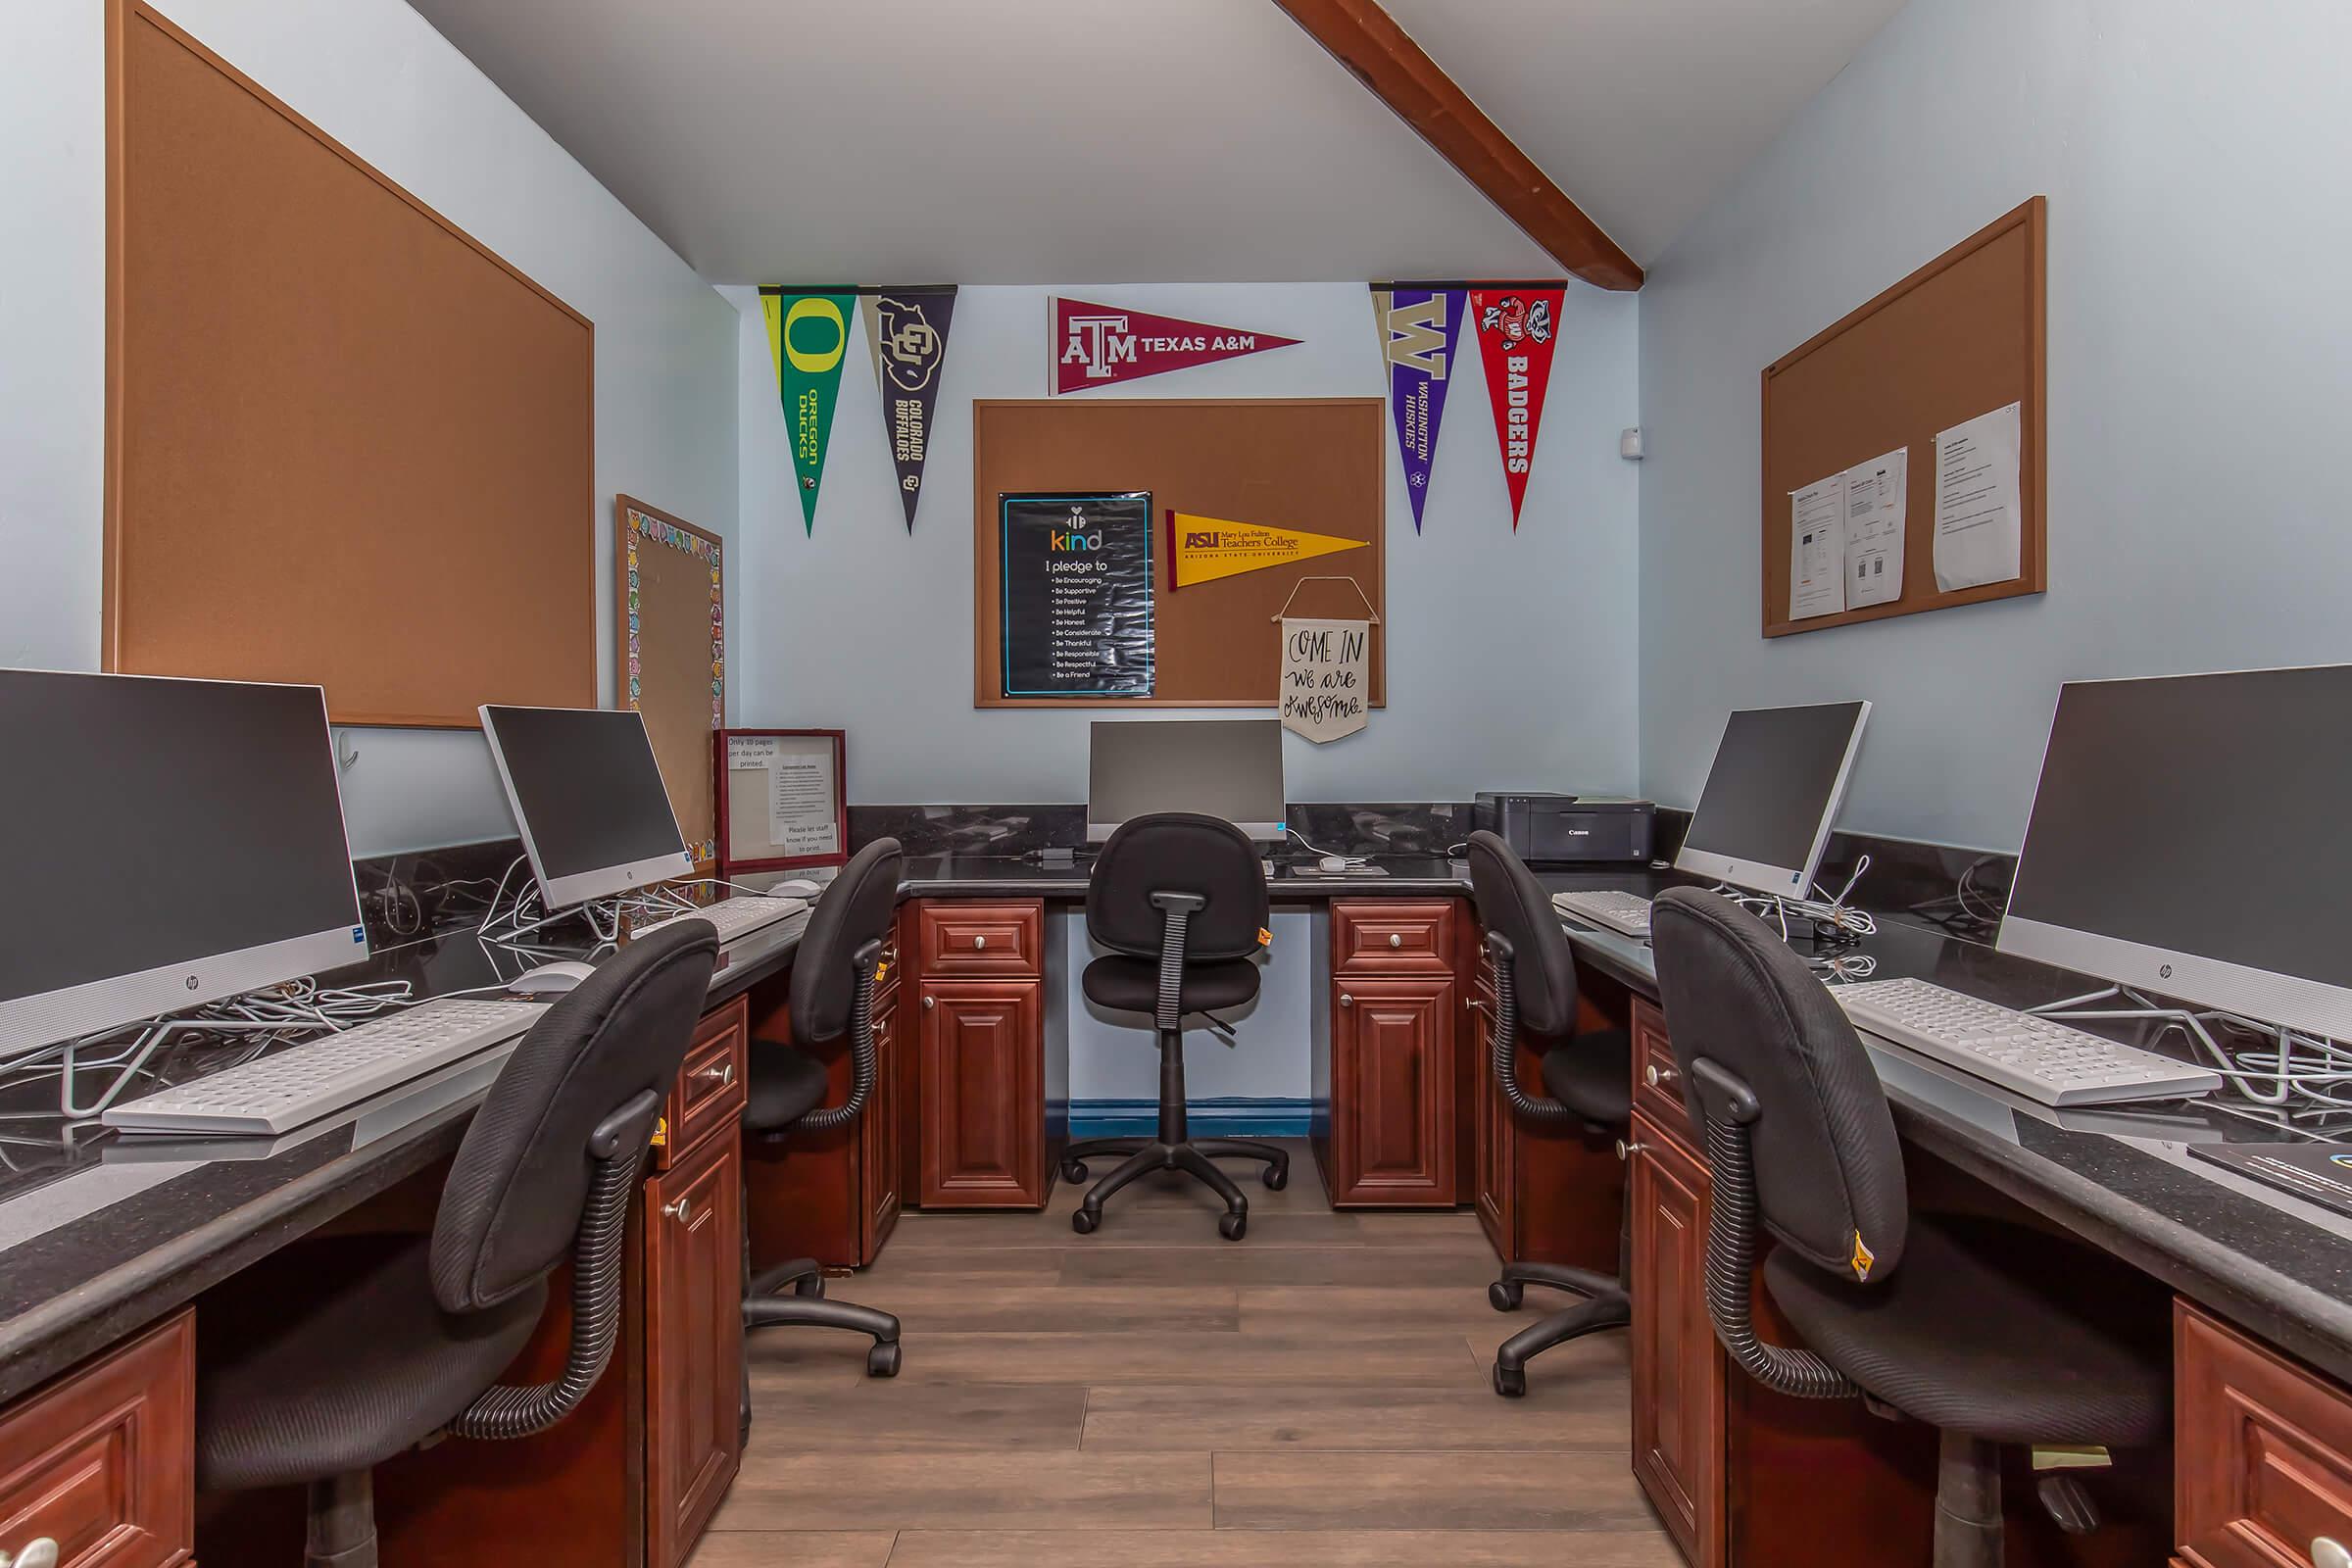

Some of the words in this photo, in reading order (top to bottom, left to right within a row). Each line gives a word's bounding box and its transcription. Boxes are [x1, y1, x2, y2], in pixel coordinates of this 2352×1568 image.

[1141, 337, 1206, 353] TEXAS
[1210, 335, 1255, 351] A&M
[1388, 293, 1446, 380] W
[799, 395, 808, 459] DUCKS
[808, 389, 817, 466] OREGON
[895, 399, 909, 462] BUFFALOES
[908, 399, 923, 462] COLORADO
[1405, 395, 1416, 449] HUSKIES
[1418, 381, 1428, 462] WASHINGTON
[1507, 356, 1529, 474] BADGERS
[1051, 529, 1102, 551] kind
[1184, 531, 1220, 549] ASU
[1221, 538, 1262, 548] Teachers
[1263, 537, 1298, 549] College
[1046, 561, 1050, 571] I
[1053, 560, 1093, 573] pledge
[1095, 561, 1107, 571] to
[1289, 630, 1334, 663] COME
[1339, 629, 1364, 664] IN
[1320, 670, 1356, 688] are
[729, 737, 744, 746] Only
